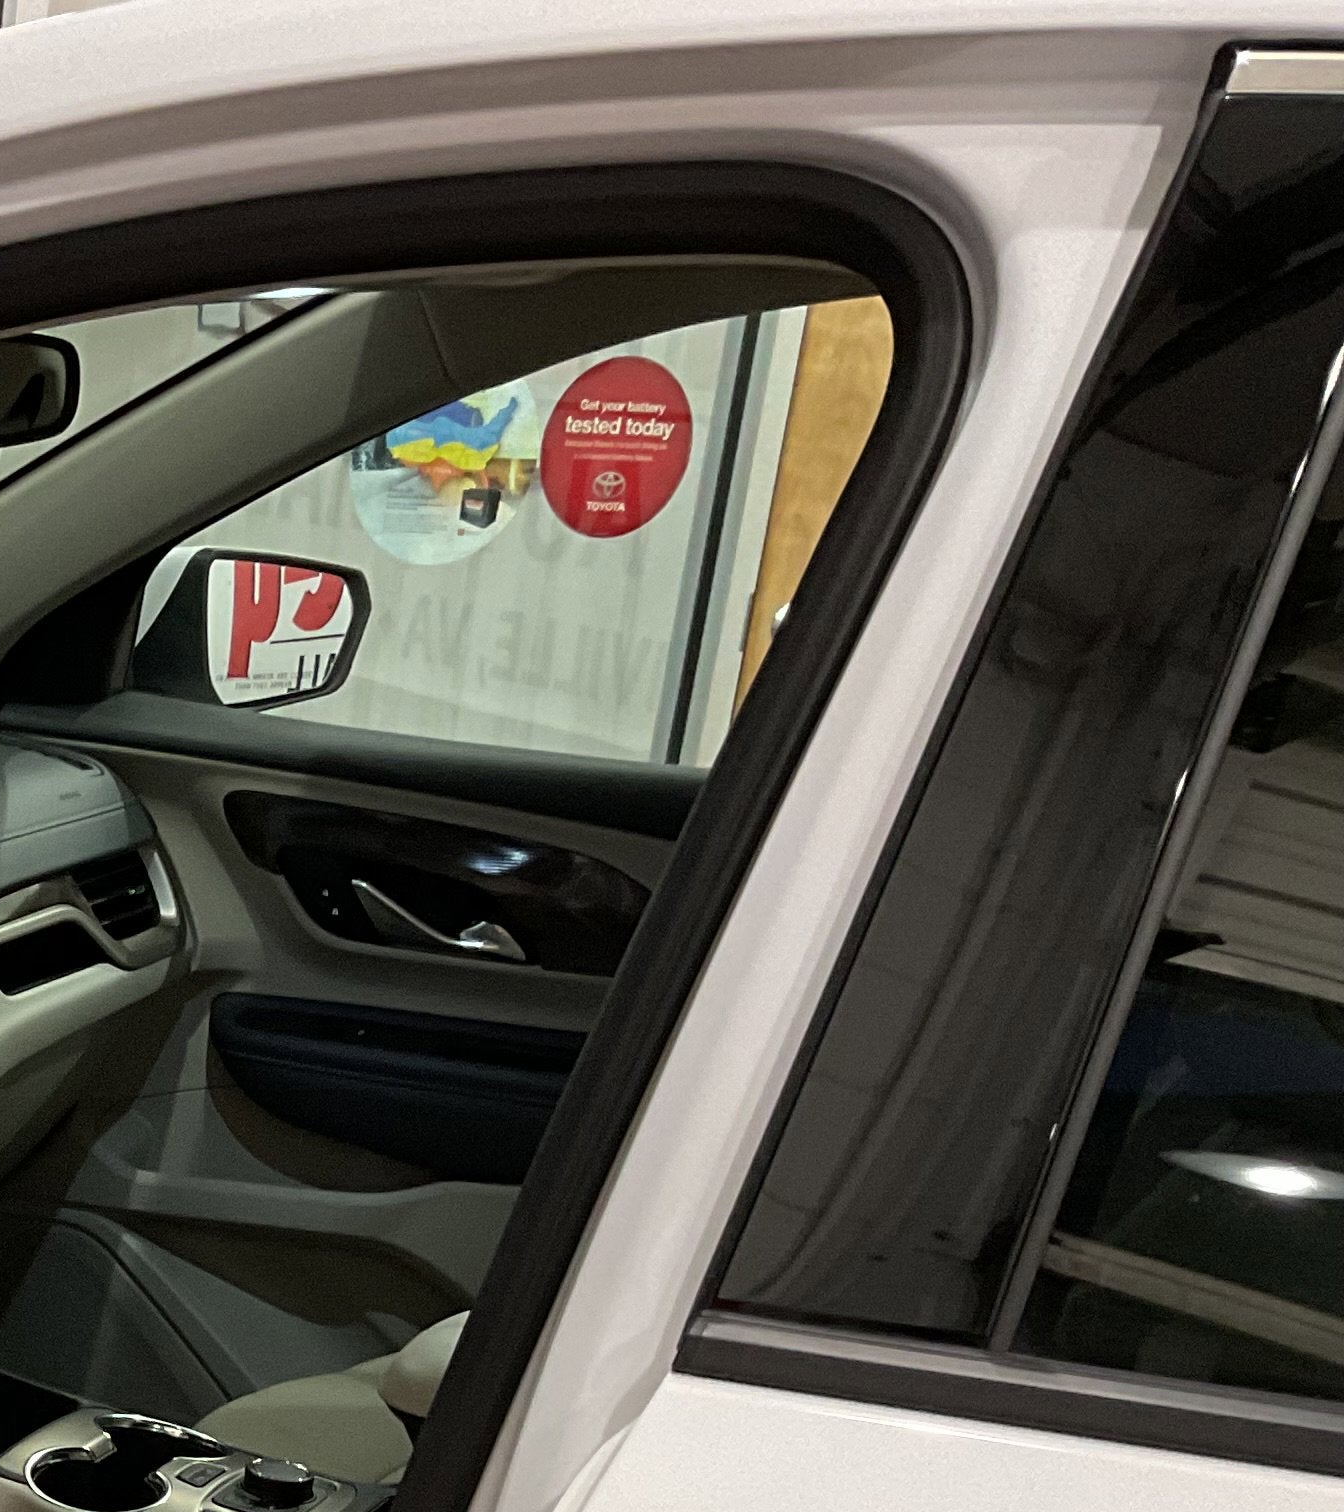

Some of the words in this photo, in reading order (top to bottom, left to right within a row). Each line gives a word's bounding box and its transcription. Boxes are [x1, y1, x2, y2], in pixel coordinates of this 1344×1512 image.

[580, 398, 600, 411] Get
[602, 401, 625, 414] your
[627, 401, 666, 416] battery
[565, 415, 622, 435] tested
[626, 418, 675, 440] today
[586, 502, 626, 512] TOYOTA
